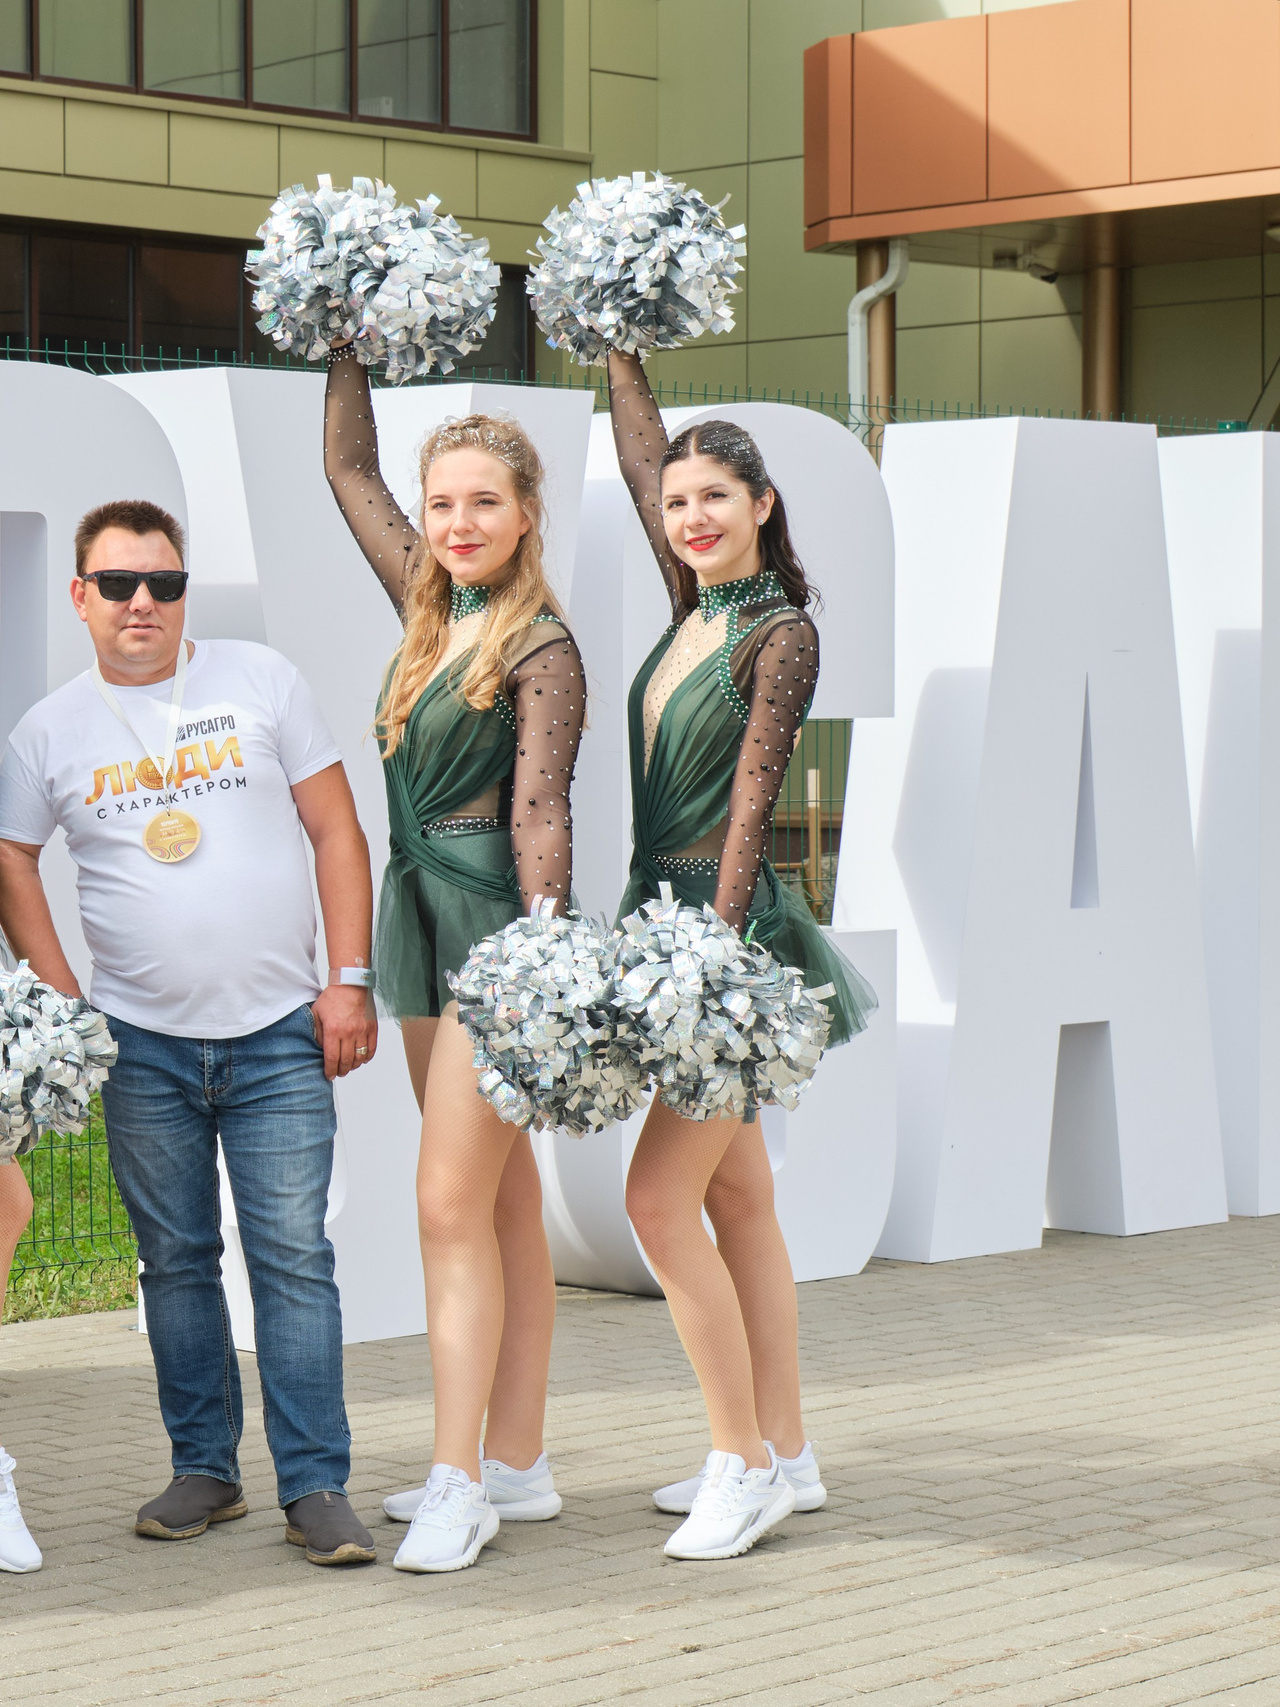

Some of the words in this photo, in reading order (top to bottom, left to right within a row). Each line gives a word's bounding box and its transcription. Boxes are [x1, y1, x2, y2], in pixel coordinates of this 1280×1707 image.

[186, 715, 235, 737] РУСАГРО
[85, 736, 243, 805] ЛЮДИ
[97, 808, 107, 819] С
[116, 777, 247, 814] ХАРАКТЕРОМ
